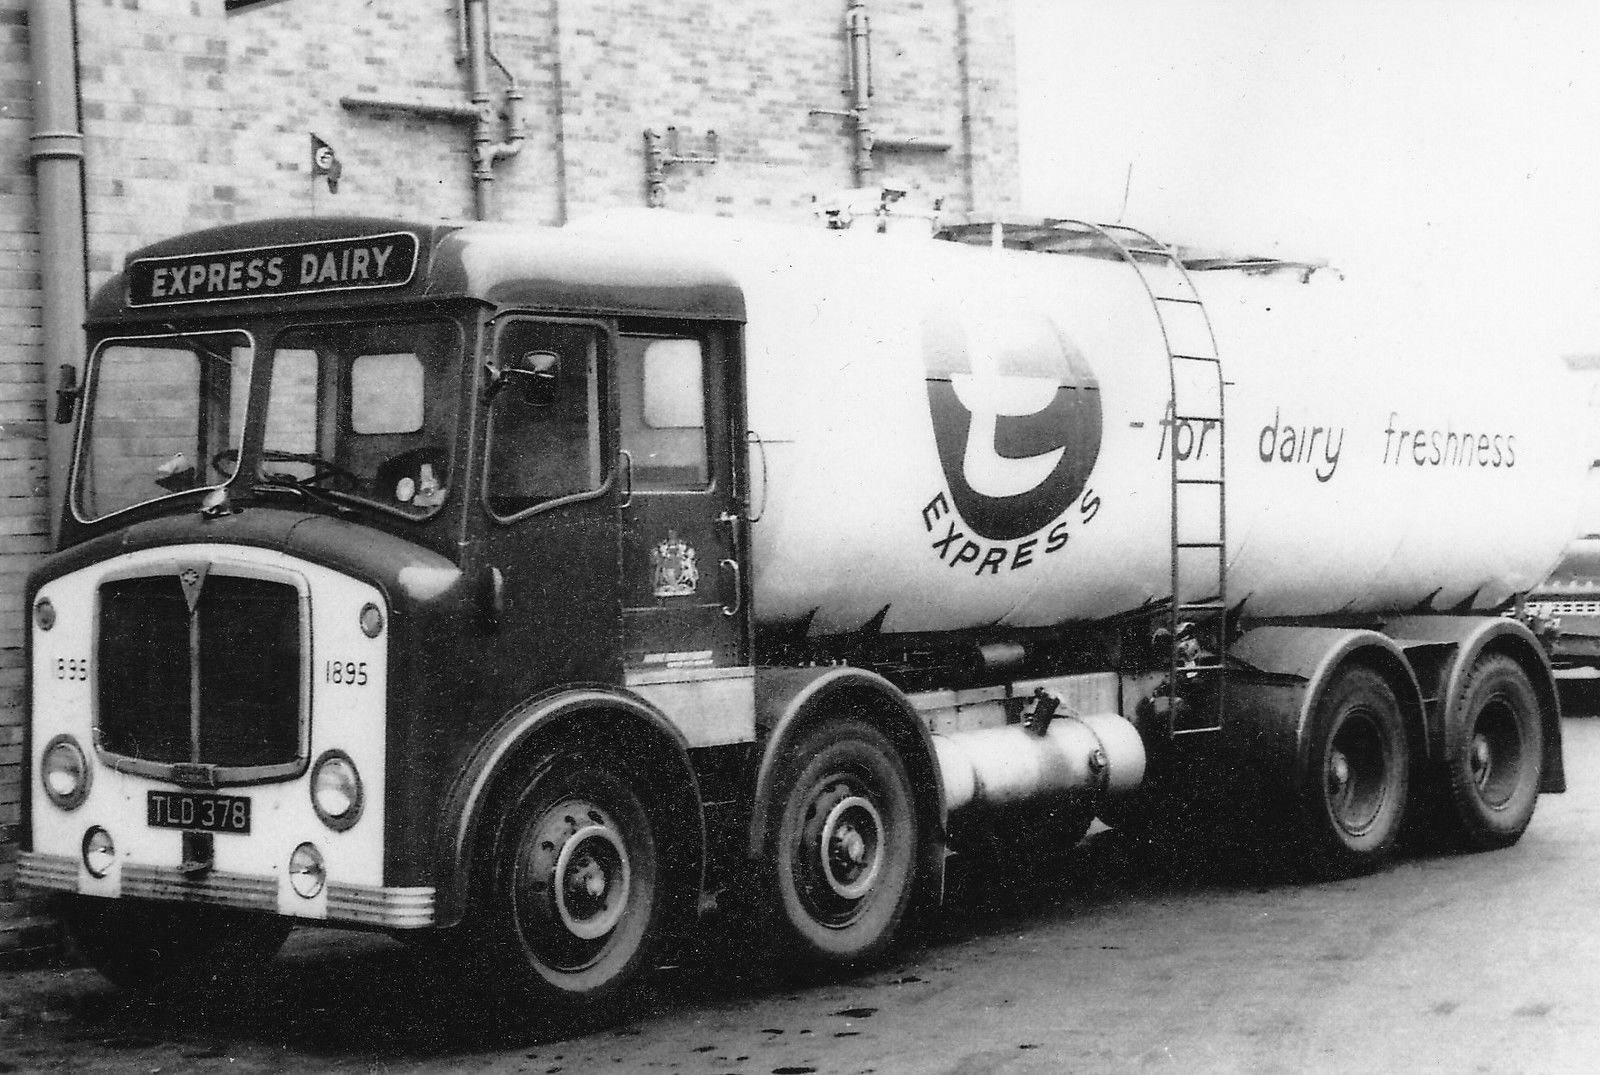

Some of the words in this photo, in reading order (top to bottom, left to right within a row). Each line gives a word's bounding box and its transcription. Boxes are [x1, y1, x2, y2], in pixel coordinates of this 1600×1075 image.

[150, 256, 284, 297] EXPRESS
[299, 245, 394, 285] DAIRY
[1157, 400, 1216, 461] for
[1258, 405, 1344, 483] dairy
[1383, 411, 1516, 468] freshness
[921, 489, 1101, 576] EXPRESS
[326, 660, 368, 685] 1895
[152, 795, 194, 824] TLD
[201, 799, 246, 828] 378
